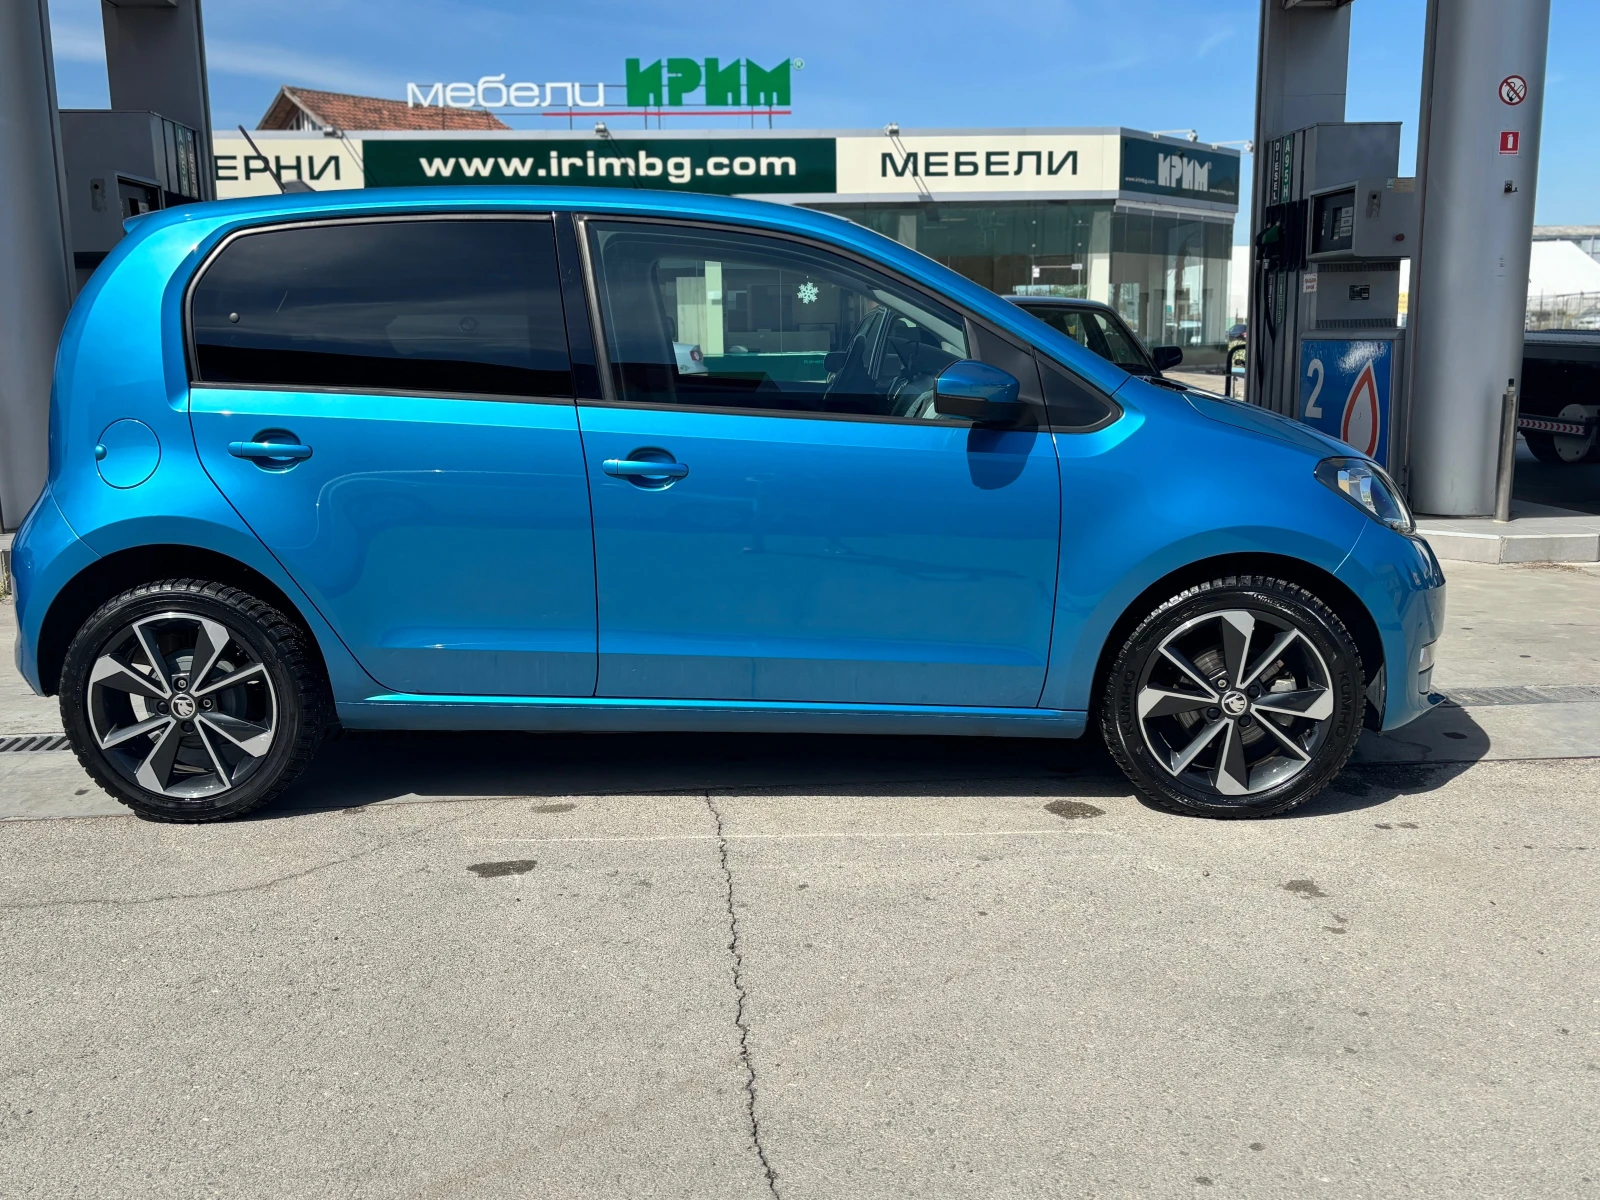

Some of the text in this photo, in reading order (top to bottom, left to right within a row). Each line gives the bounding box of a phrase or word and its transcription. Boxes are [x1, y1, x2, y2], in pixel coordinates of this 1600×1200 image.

[407, 73, 605, 109] мебели
[419, 150, 797, 184] www.irimbg.com
[881, 150, 1079, 178] МЕБЕЛИ
[1304, 358, 1325, 419] 2
[1336, 670, 1353, 738] KUMHO
